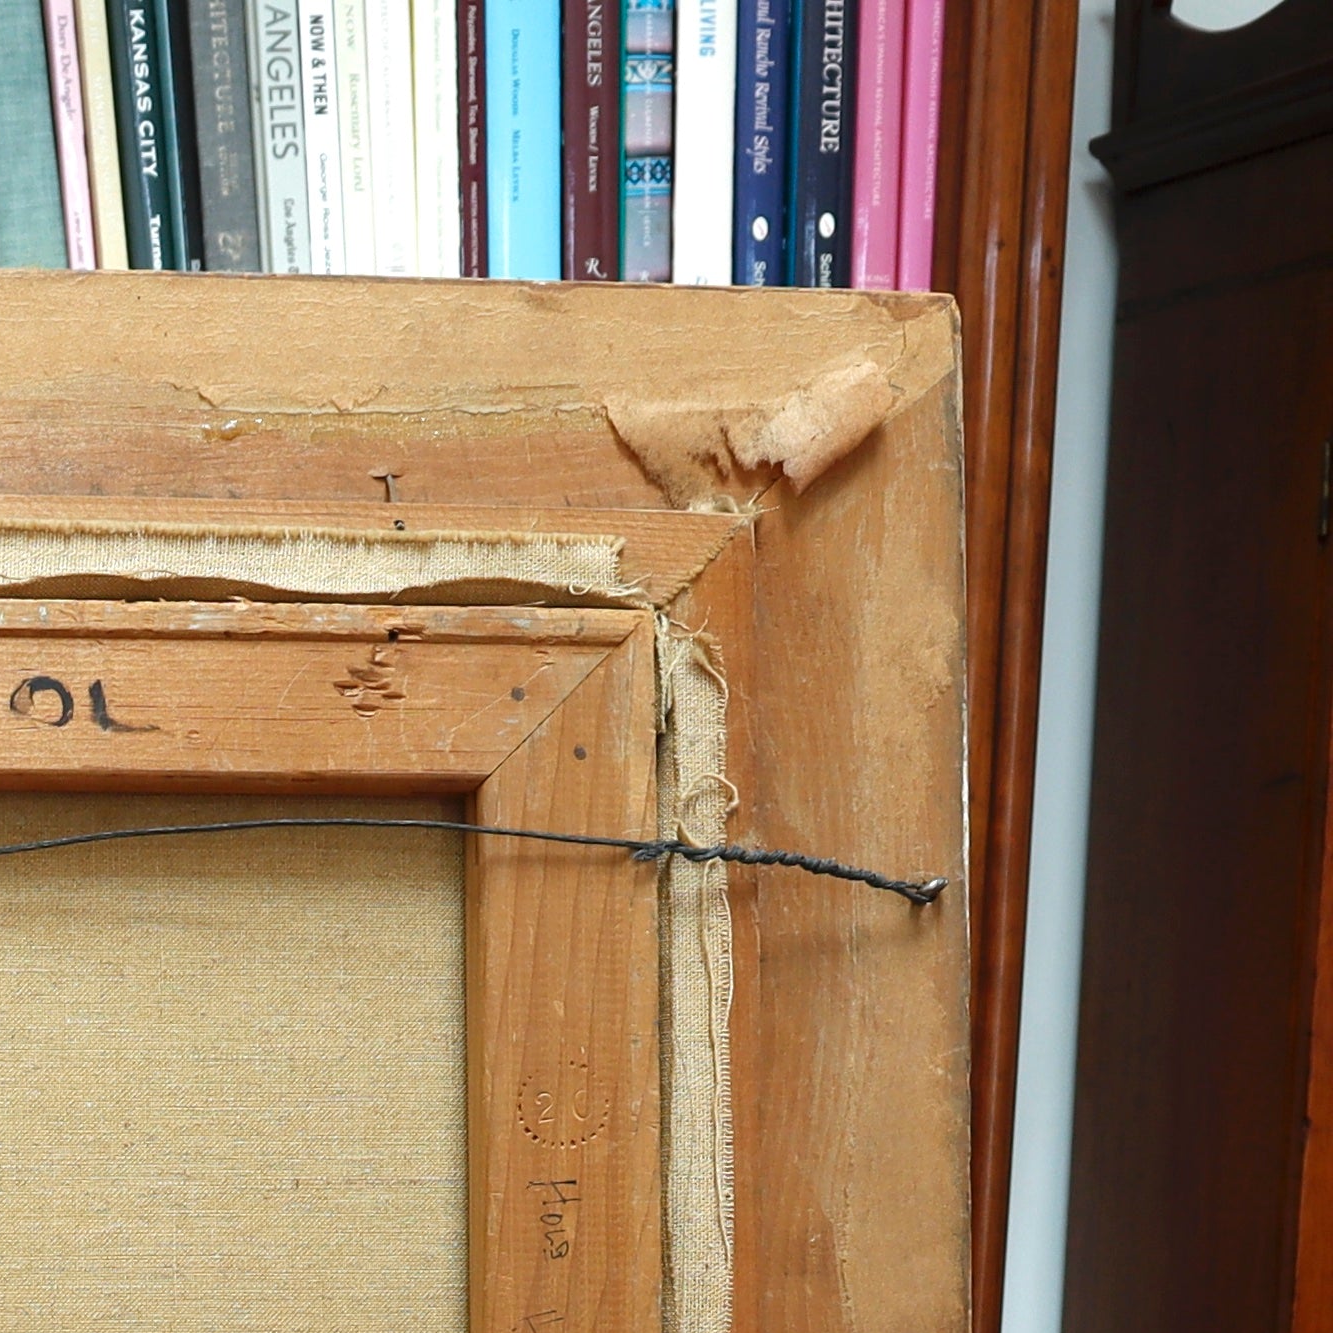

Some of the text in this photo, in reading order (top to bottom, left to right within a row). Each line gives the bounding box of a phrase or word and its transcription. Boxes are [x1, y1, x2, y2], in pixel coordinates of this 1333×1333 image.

[586, 0, 603, 88] NGELES
[699, 0, 717, 57] LIVING
[755, 28, 776, 77] Rancho
[129, 8, 159, 178] KANSAS CITY
[264, 4, 300, 160] ANGELES
[309, 14, 329, 116] NOW & THEN
[510, 28, 522, 116] DOUGLAS WOODS
[348, 72, 363, 150] Rosemary
[754, 82, 775, 131] Revival
[318, 152, 330, 202] George
[352, 156, 365, 193] Lord
[745, 135, 774, 176] Styles
[322, 207, 331, 240] Ross
